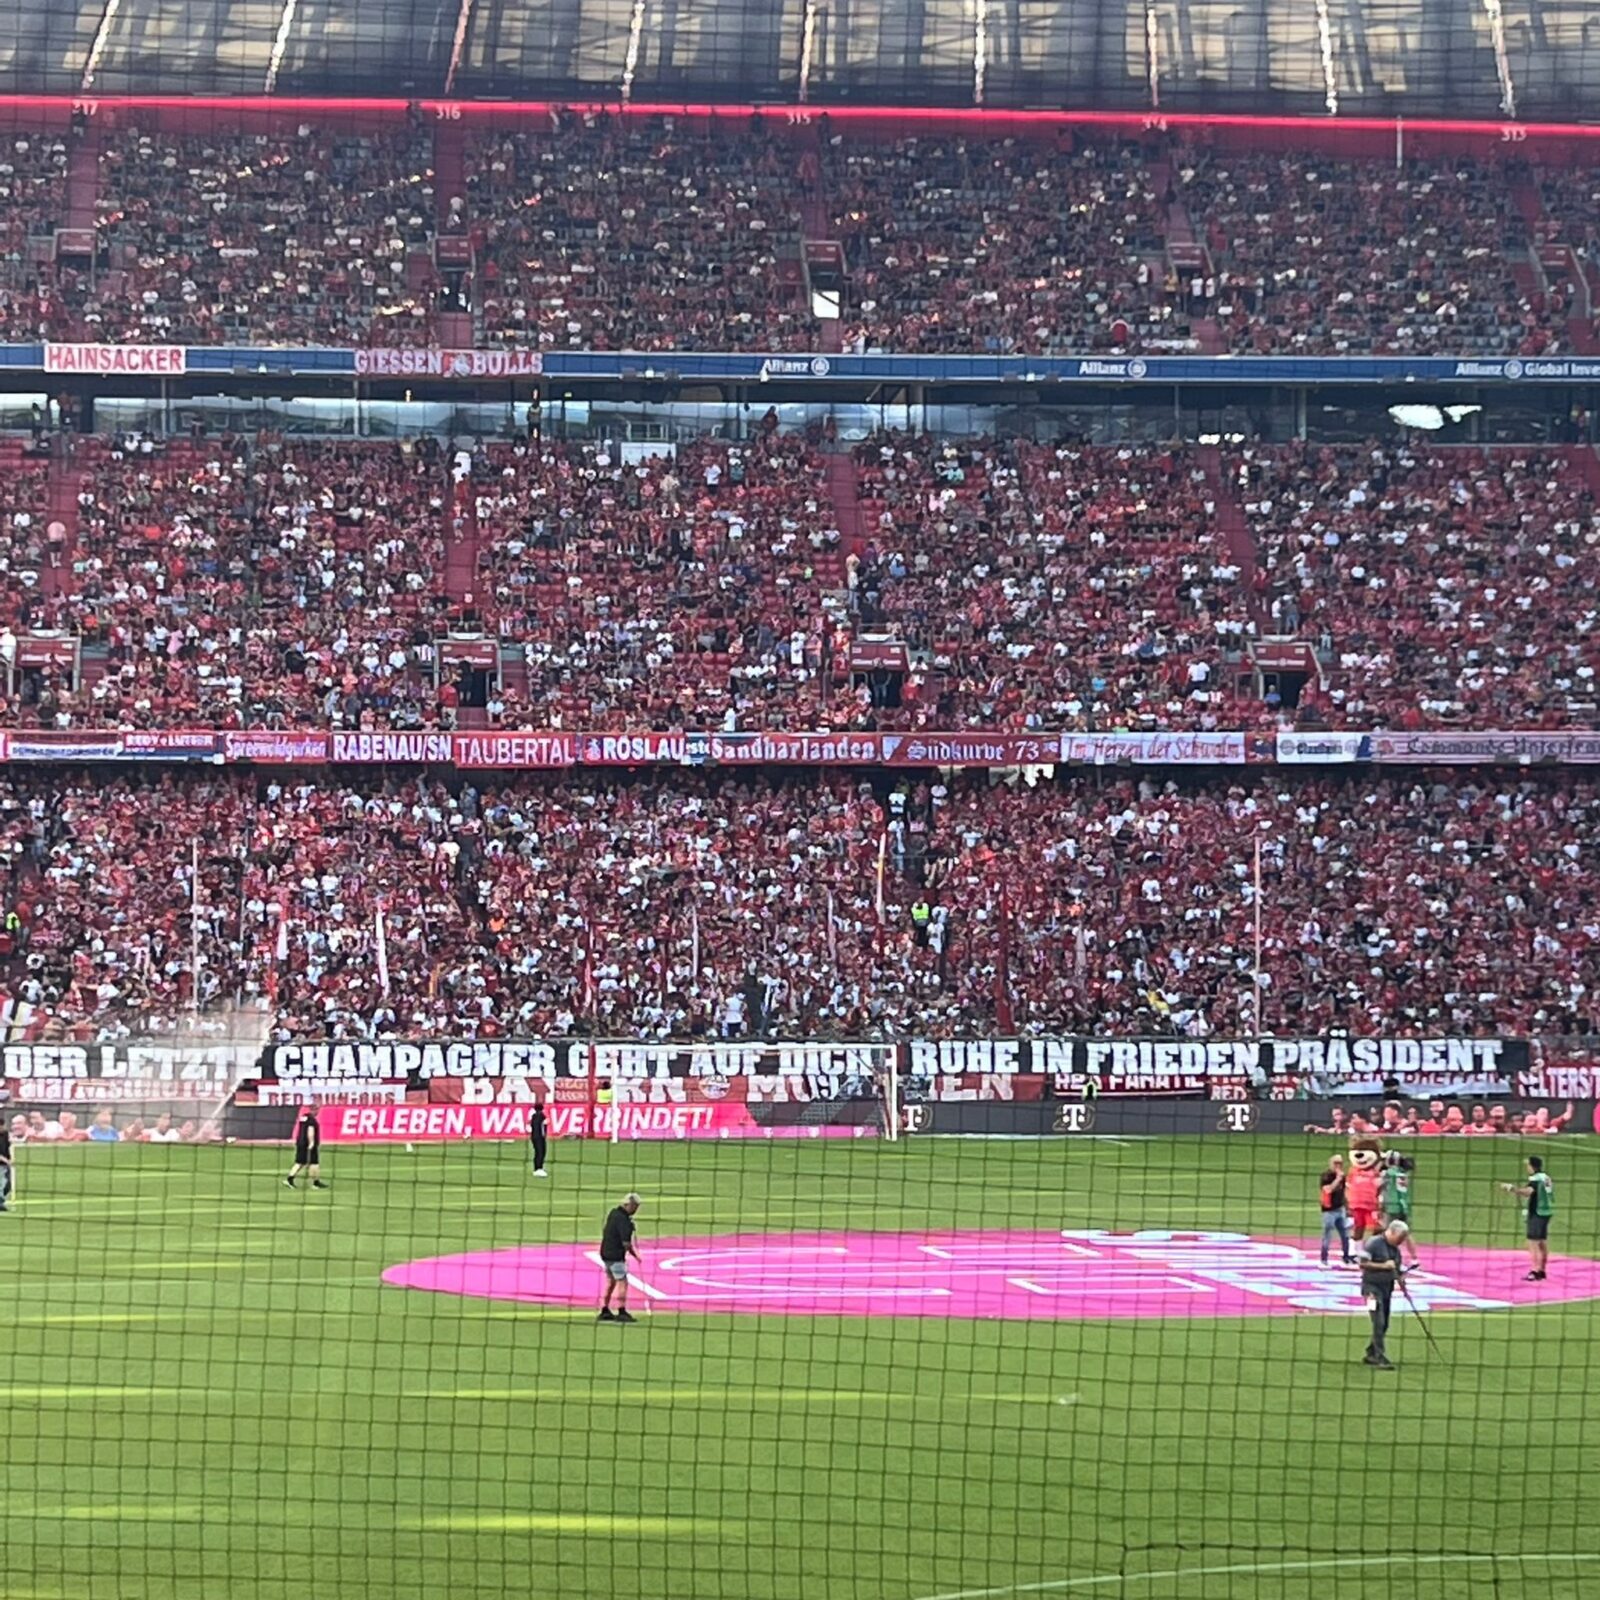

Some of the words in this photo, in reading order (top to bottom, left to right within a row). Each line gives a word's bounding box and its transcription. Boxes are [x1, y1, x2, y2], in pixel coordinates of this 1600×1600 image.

[435, 102, 461, 120] 316
[786, 109, 812, 126] 315
[1500, 124, 1527, 141] 313
[47, 347, 183, 371] HAINSACKER
[354, 350, 442, 375] GIESSEN
[470, 351, 544, 376] BULLS
[761, 359, 809, 374] Allianz
[1079, 360, 1126, 375] Allianz
[1455, 362, 1503, 376] Allianz
[1524, 362, 1569, 376] Global
[333, 734, 451, 760] RABENAU/SN
[456, 738, 576, 765] TAUBERTAL
[907, 738, 1005, 761] Südkurve
[4, 1046, 88, 1078] DER
[273, 1043, 557, 1078] CHAMPAGNER
[568, 1043, 679, 1077] GEHT
[688, 1042, 766, 1076] AUF
[776, 1042, 875, 1076] DICH
[910, 1041, 1020, 1074] RUHE
[1031, 1041, 1074, 1074] IN
[1086, 1041, 1261, 1075] FRIEDEN
[1271, 1032, 1504, 1073] PRÄSIDENT
[341, 1108, 473, 1139] ERLEBEN,
[551, 1107, 714, 1135] VERBINDET!
